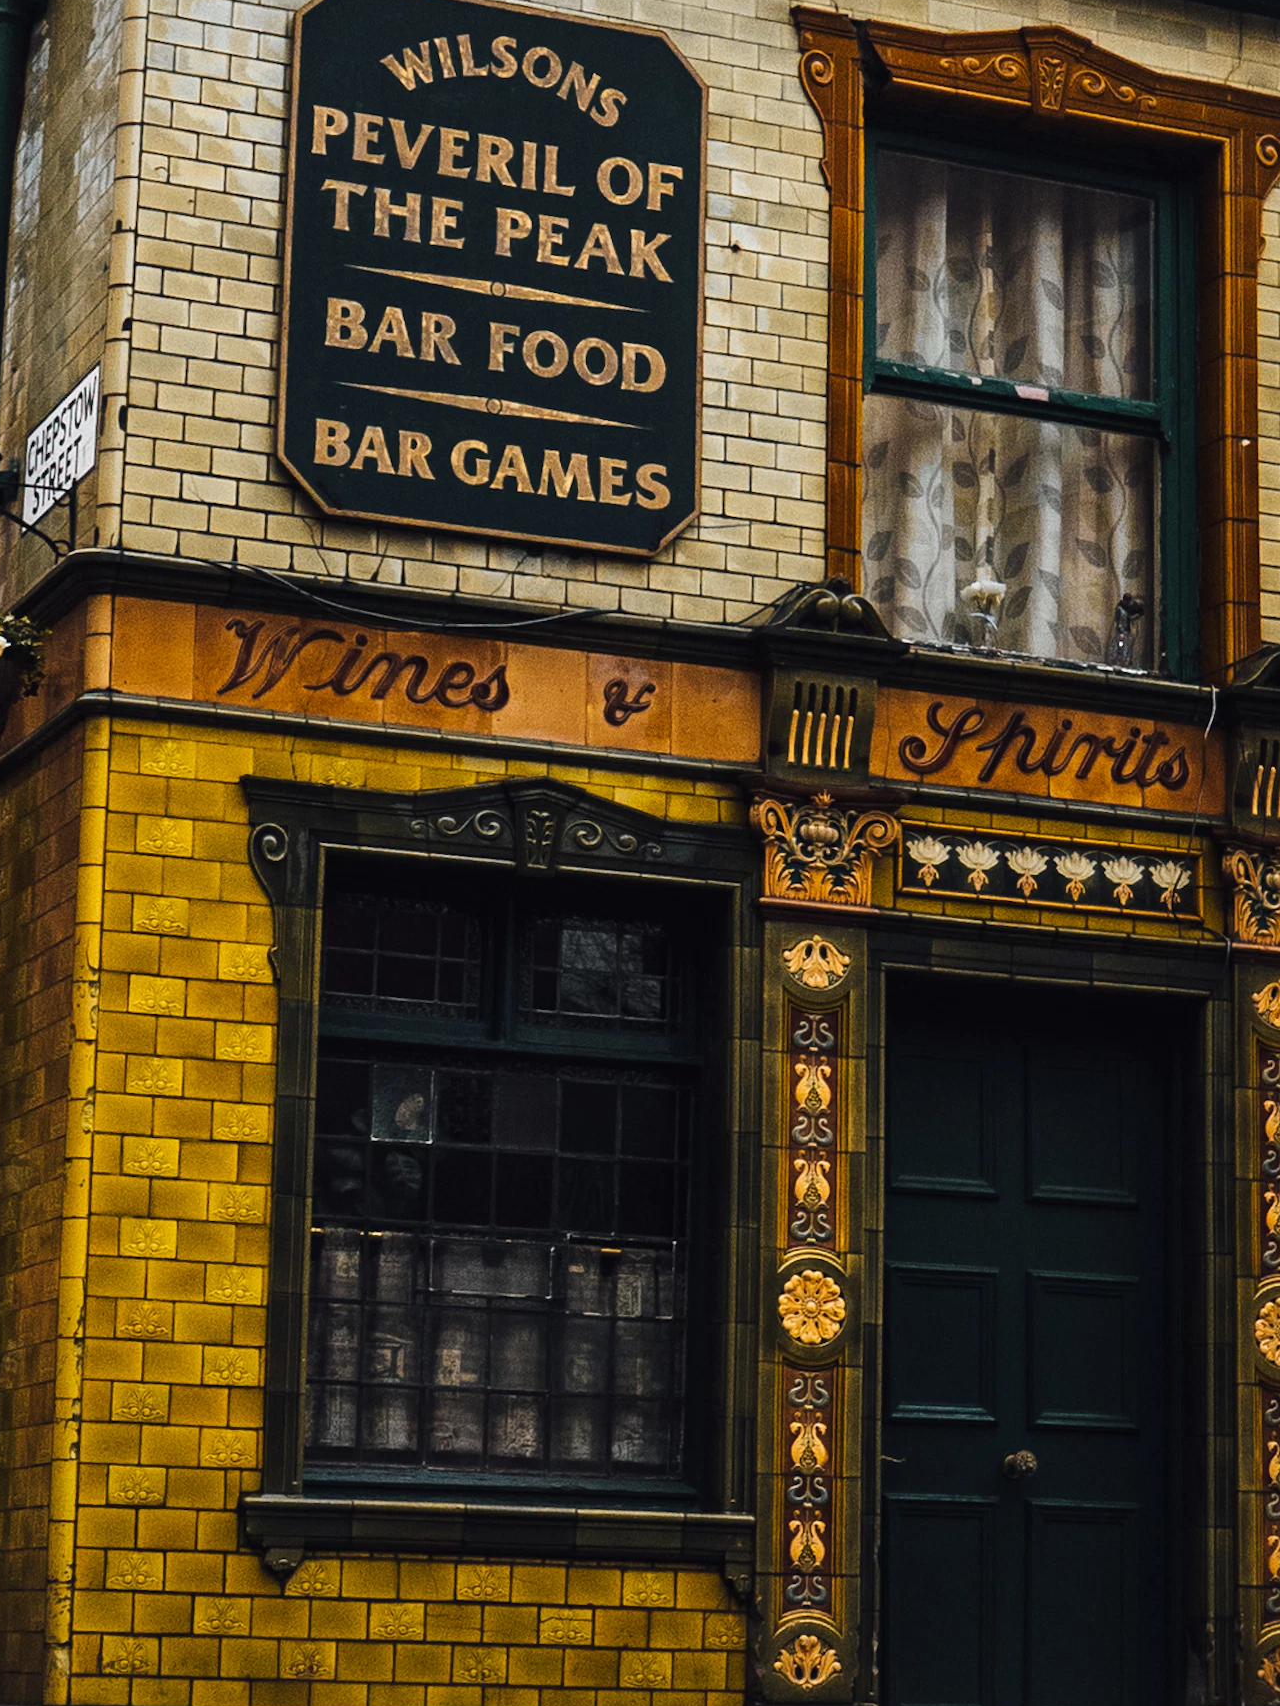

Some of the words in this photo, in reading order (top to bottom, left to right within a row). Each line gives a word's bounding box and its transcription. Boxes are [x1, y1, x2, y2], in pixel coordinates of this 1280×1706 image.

[380, 33, 628, 127] WILSONS
[310, 104, 576, 198] PEVERIL
[596, 155, 684, 211] OF
[319, 178, 466, 249] THE
[494, 206, 675, 283] PEAK
[324, 297, 462, 366] BAR
[487, 320, 668, 394] FOOD
[26, 375, 98, 478] CHEPSTOW
[32, 434, 83, 515] STREET
[313, 418, 437, 480] BAR
[451, 438, 672, 511] GAMES
[217, 615, 511, 712] Wines
[603, 676, 657, 727] &
[897, 700, 1191, 791] Spirits
